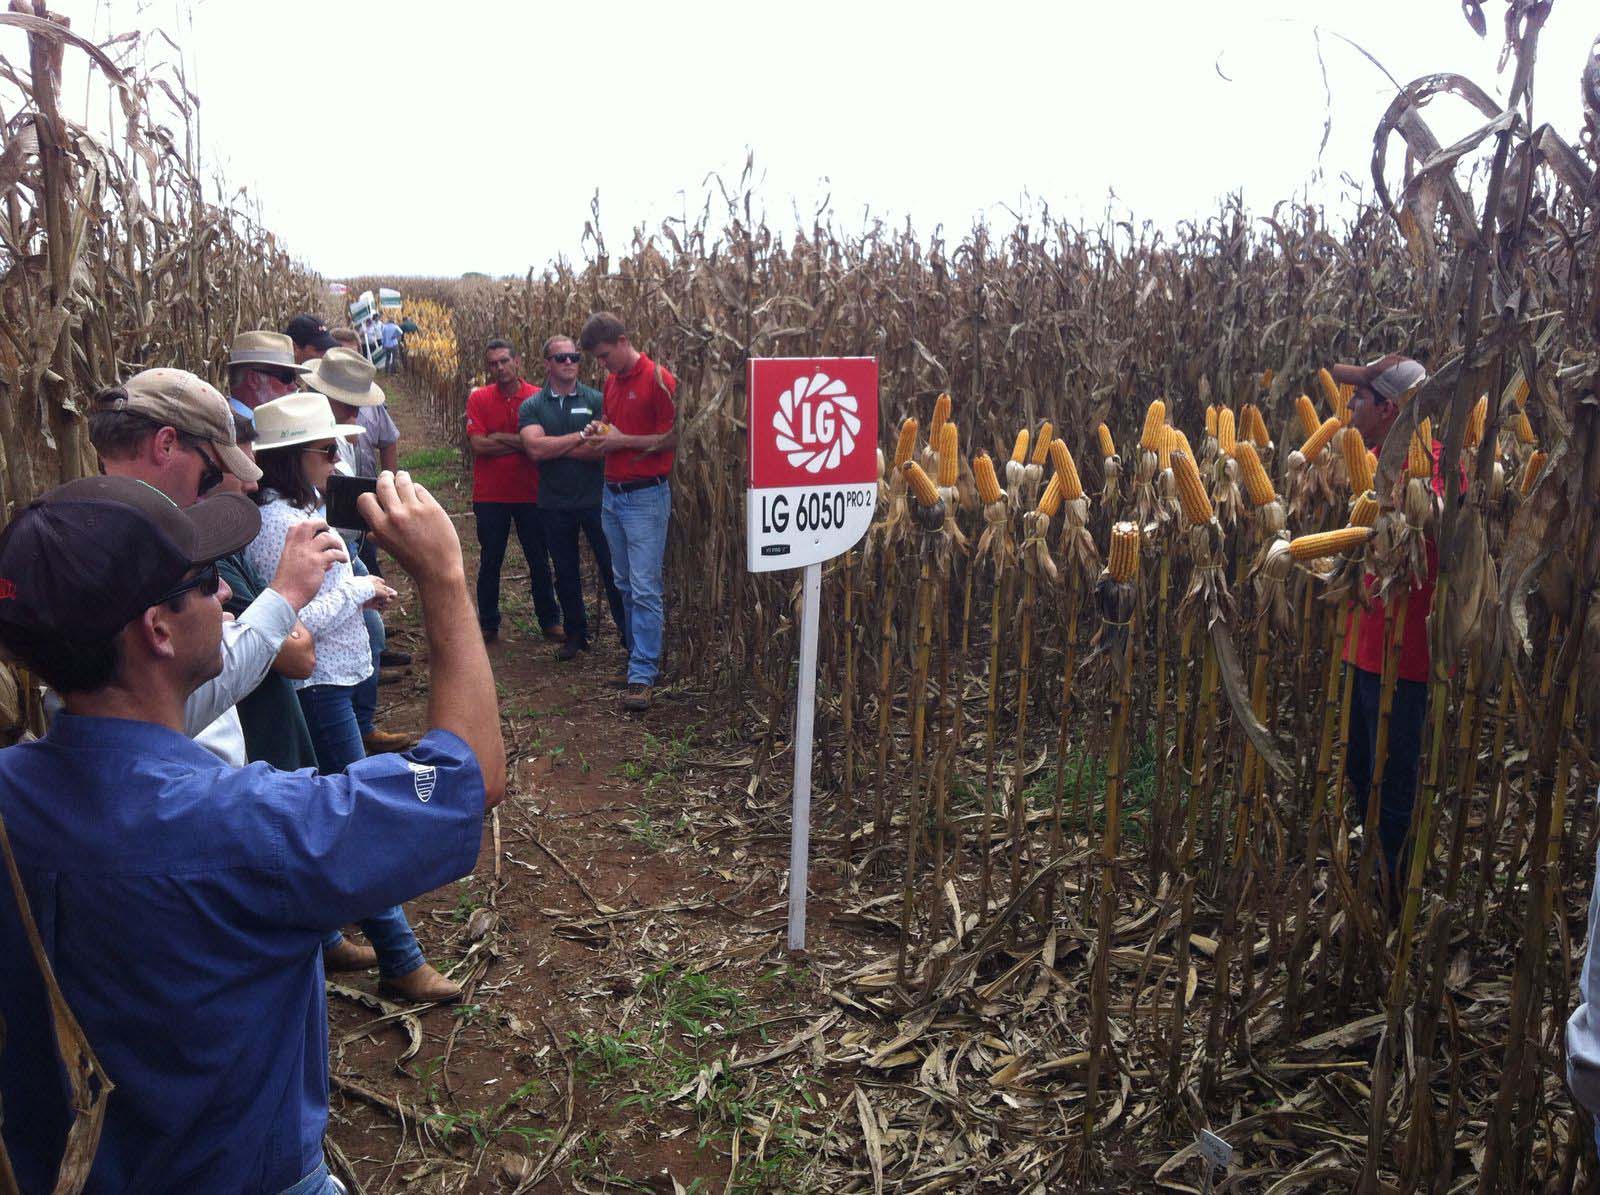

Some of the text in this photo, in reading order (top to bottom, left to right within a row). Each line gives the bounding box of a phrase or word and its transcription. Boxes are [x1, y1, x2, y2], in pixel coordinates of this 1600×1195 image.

[802, 401, 835, 443] LG
[762, 490, 871, 533] LG 6050 PRO 2
